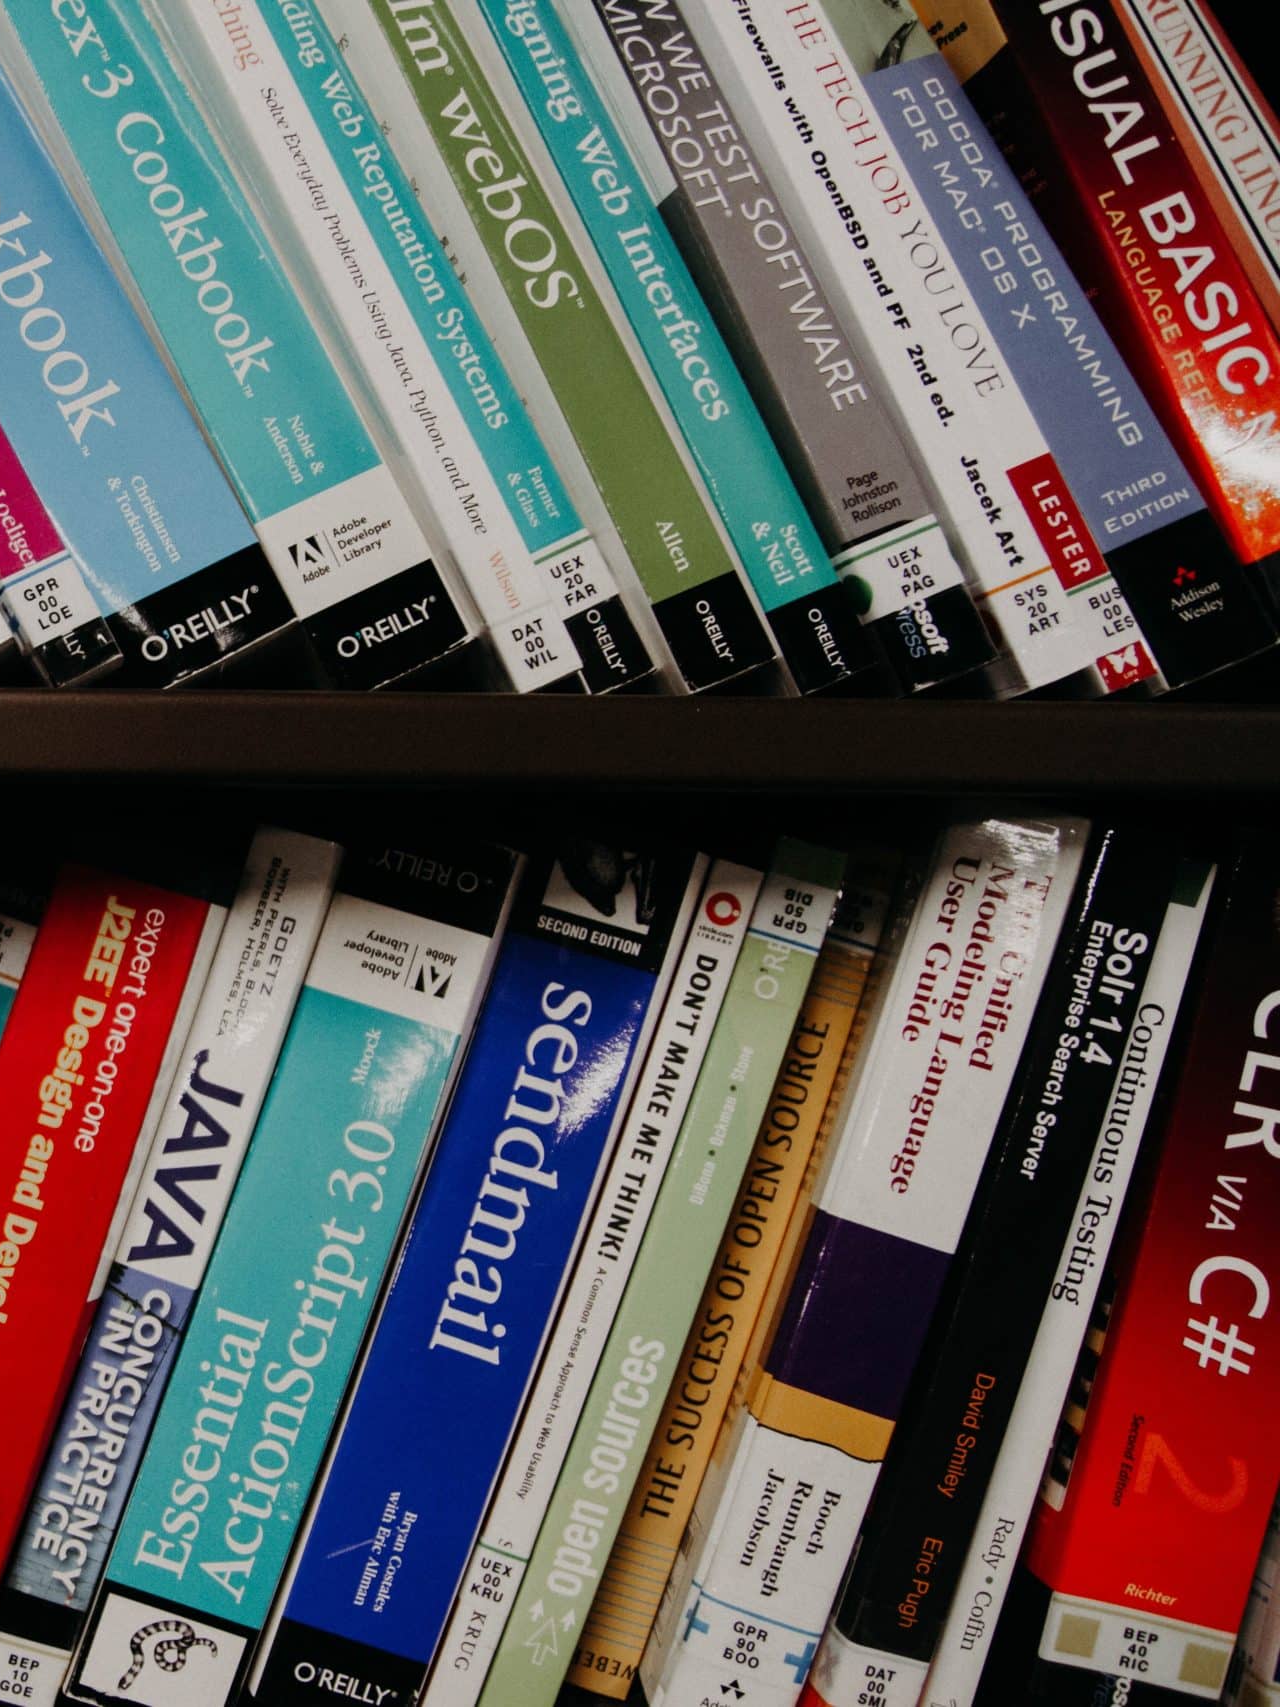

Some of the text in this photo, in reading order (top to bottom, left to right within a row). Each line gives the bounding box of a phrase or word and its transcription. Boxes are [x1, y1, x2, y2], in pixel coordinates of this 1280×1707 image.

[662, 32, 869, 412] WE TEST SOFTWARE
[814, 54, 1006, 399] TECH JOB YOU LOVE
[892, 86, 1037, 330] FOR OS X
[319, 69, 509, 430] Web Reputation Systems
[574, 124, 730, 424] Web Interfaces
[782, 97, 815, 145] with
[810, 149, 870, 252] OpenBSD
[862, 258, 895, 299] and
[886, 301, 912, 332] PF
[905, 344, 939, 388] 2nd
[929, 390, 951, 428] ed.
[260, 85, 488, 536] Solve Everyday Problems Using Java, Python, and More
[1137, 190, 1272, 397] BASIC
[842, 478, 899, 510] Johnston
[846, 470, 879, 491] Page
[852, 497, 902, 525] Rollison
[960, 455, 1026, 569] Jacek Art
[1101, 470, 1167, 507] THIRD
[1103, 488, 1191, 535] EDITION
[332, 514, 368, 538] Adobe
[337, 517, 393, 550] Developer
[342, 538, 383, 565] Library
[655, 519, 689, 573] Allen
[778, 523, 815, 577] Scott
[887, 546, 923, 569] UEX
[1030, 478, 1092, 579] LESTER
[488, 549, 522, 610] Wilson
[550, 555, 586, 581] UEX
[564, 583, 598, 607] FAR
[565, 573, 585, 591] 20
[901, 576, 936, 599] PAG
[903, 564, 921, 580] 40
[536, 914, 642, 958] SECOND EDITION
[901, 855, 982, 1042] User Guide
[73, 907, 166, 1154] expert one-on-one
[676, 953, 719, 1038] DON'T
[646, 1039, 690, 1119] MAKE
[888, 1029, 965, 1195] Language
[127, 1048, 245, 1263] JAVA
[429, 980, 593, 1366] sendmail
[629, 1121, 662, 1165] ME
[1051, 1002, 1166, 1306] Continuous Testing
[596, 1172, 647, 1263] THINK!
[578, 1279, 599, 1325] Common
[639, 1020, 831, 1519] THE SUCCESS OF OPEN SOURCE
[197, 1119, 396, 1604] ActionScript 3.0
[568, 1325, 588, 1362] Sense
[543, 1411, 557, 1427] to
[549, 1361, 576, 1413] Approach
[32, 1306, 137, 1562] IN PRACTICE
[50, 1288, 172, 1599] CONCURRENCY
[133, 1306, 270, 1581] Essential
[535, 1427, 551, 1450] Web
[546, 1333, 667, 1598] open sources
[936, 1371, 996, 1500] David Smiley
[515, 1450, 544, 1500] Usability
[352, 1490, 401, 1608] with Eric Allman
[739, 1467, 786, 1568] Jacobson
[759, 1478, 815, 1599] Rumbaugh
[805, 1488, 842, 1556] Booch
[372, 1510, 419, 1614] Bryan Costales
[896, 1535, 944, 1630] Eric Pugh
[1123, 1583, 1178, 1608] Richter
[453, 1610, 488, 1674] KRUG
[1117, 1656, 1151, 1674] RIC
[1123, 1627, 1160, 1646] BEP
[1127, 1643, 1148, 1659] 40
